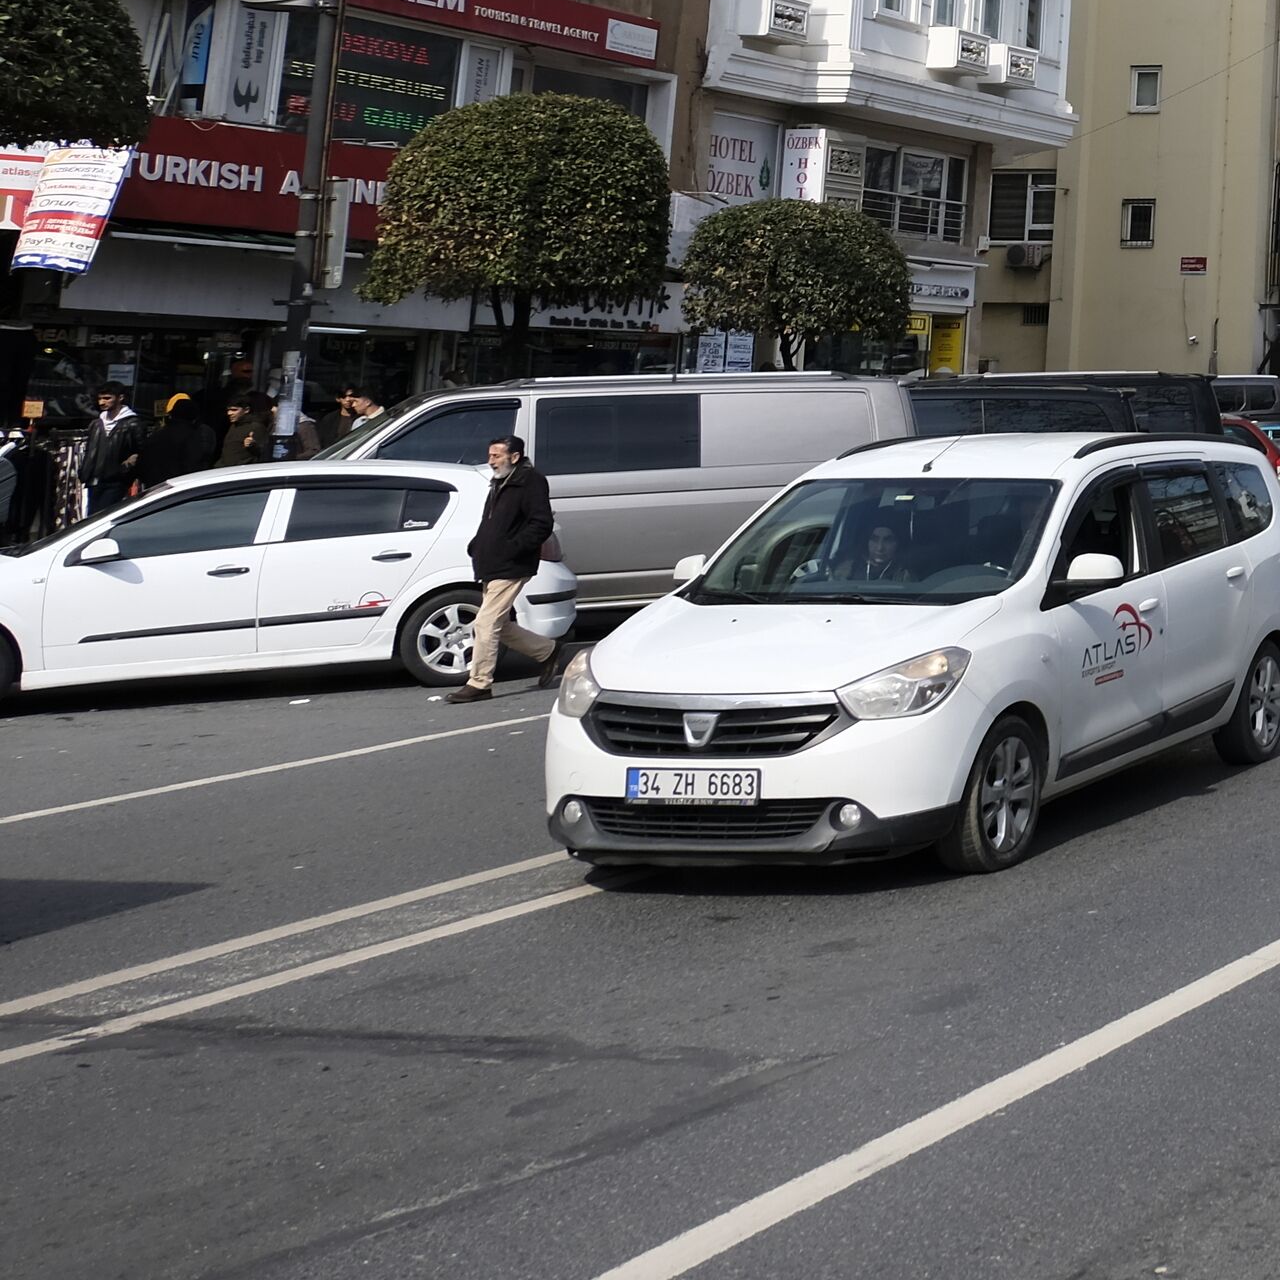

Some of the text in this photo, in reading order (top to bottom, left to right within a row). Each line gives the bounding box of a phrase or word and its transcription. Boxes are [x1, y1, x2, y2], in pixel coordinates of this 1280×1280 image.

[474, 5, 518, 26] TOURISM
[528, 17, 563, 36] TRAVEL
[563, 26, 600, 43] AGENCY
[709, 135, 756, 164] HOTEL
[786, 132, 823, 150] ÖZBEK
[121, 151, 263, 193] TURKISH
[706, 164, 754, 198] ÖZBEK
[90, 334, 134, 345] SHOES
[327, 603, 352, 612] OPEL
[1082, 633, 1137, 669] ATLAS
[639, 772, 756, 796] 34 ZH 6683
